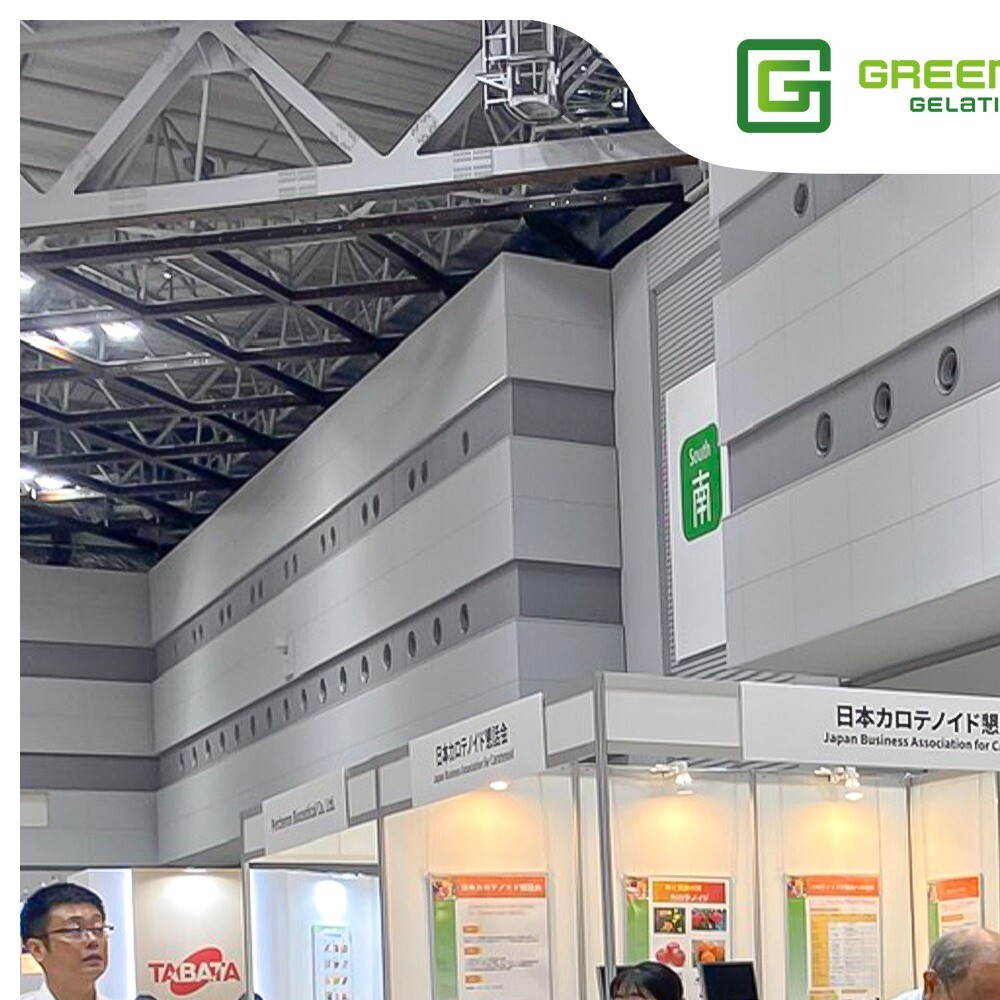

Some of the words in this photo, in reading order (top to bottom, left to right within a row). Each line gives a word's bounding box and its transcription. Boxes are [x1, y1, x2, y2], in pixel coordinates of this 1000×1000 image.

[689, 440, 711, 467] South
[691, 469, 712, 529] 南
[823, 730, 858, 747] Japan
[860, 732, 909, 748] Business
[910, 736, 973, 750] Association
[973, 738, 990, 751] for
[148, 962, 241, 983] TABATA
